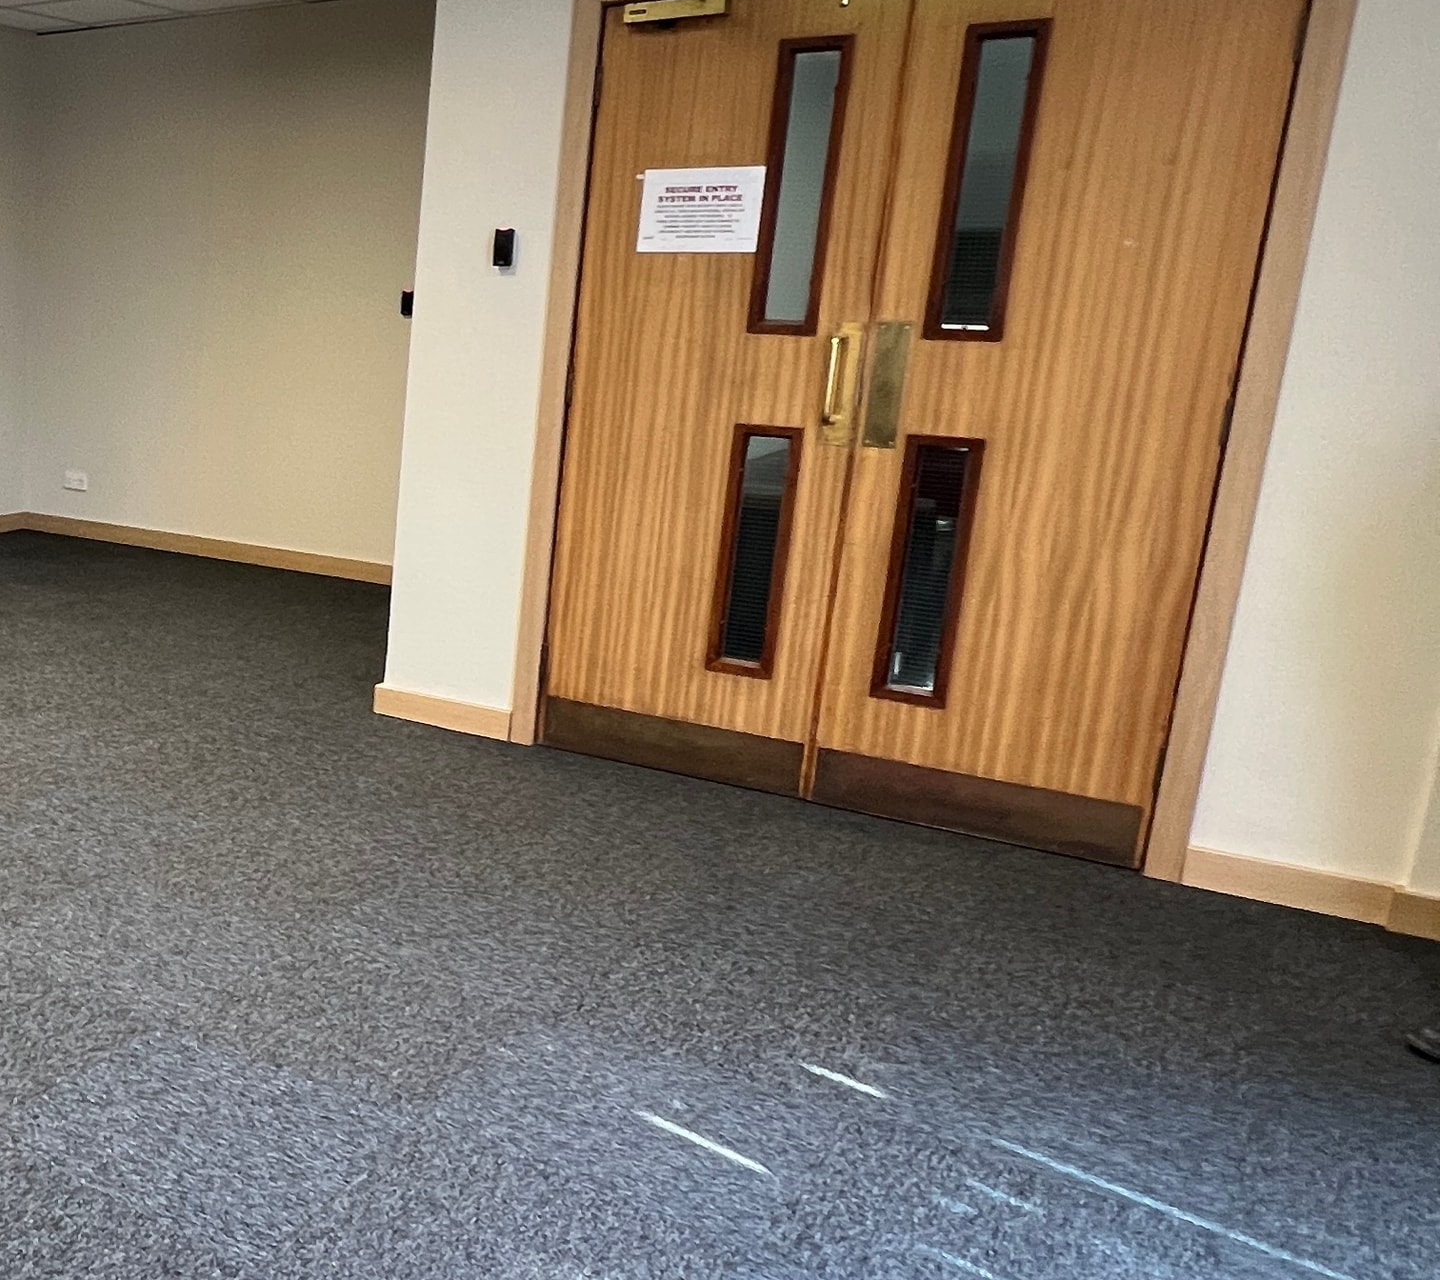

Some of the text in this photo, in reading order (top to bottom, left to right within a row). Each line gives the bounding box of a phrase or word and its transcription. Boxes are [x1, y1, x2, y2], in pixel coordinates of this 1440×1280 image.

[665, 185, 738, 194] SECURE ENTRY
[658, 195, 696, 203] SYSTEM
[711, 194, 743, 202] PLACE
